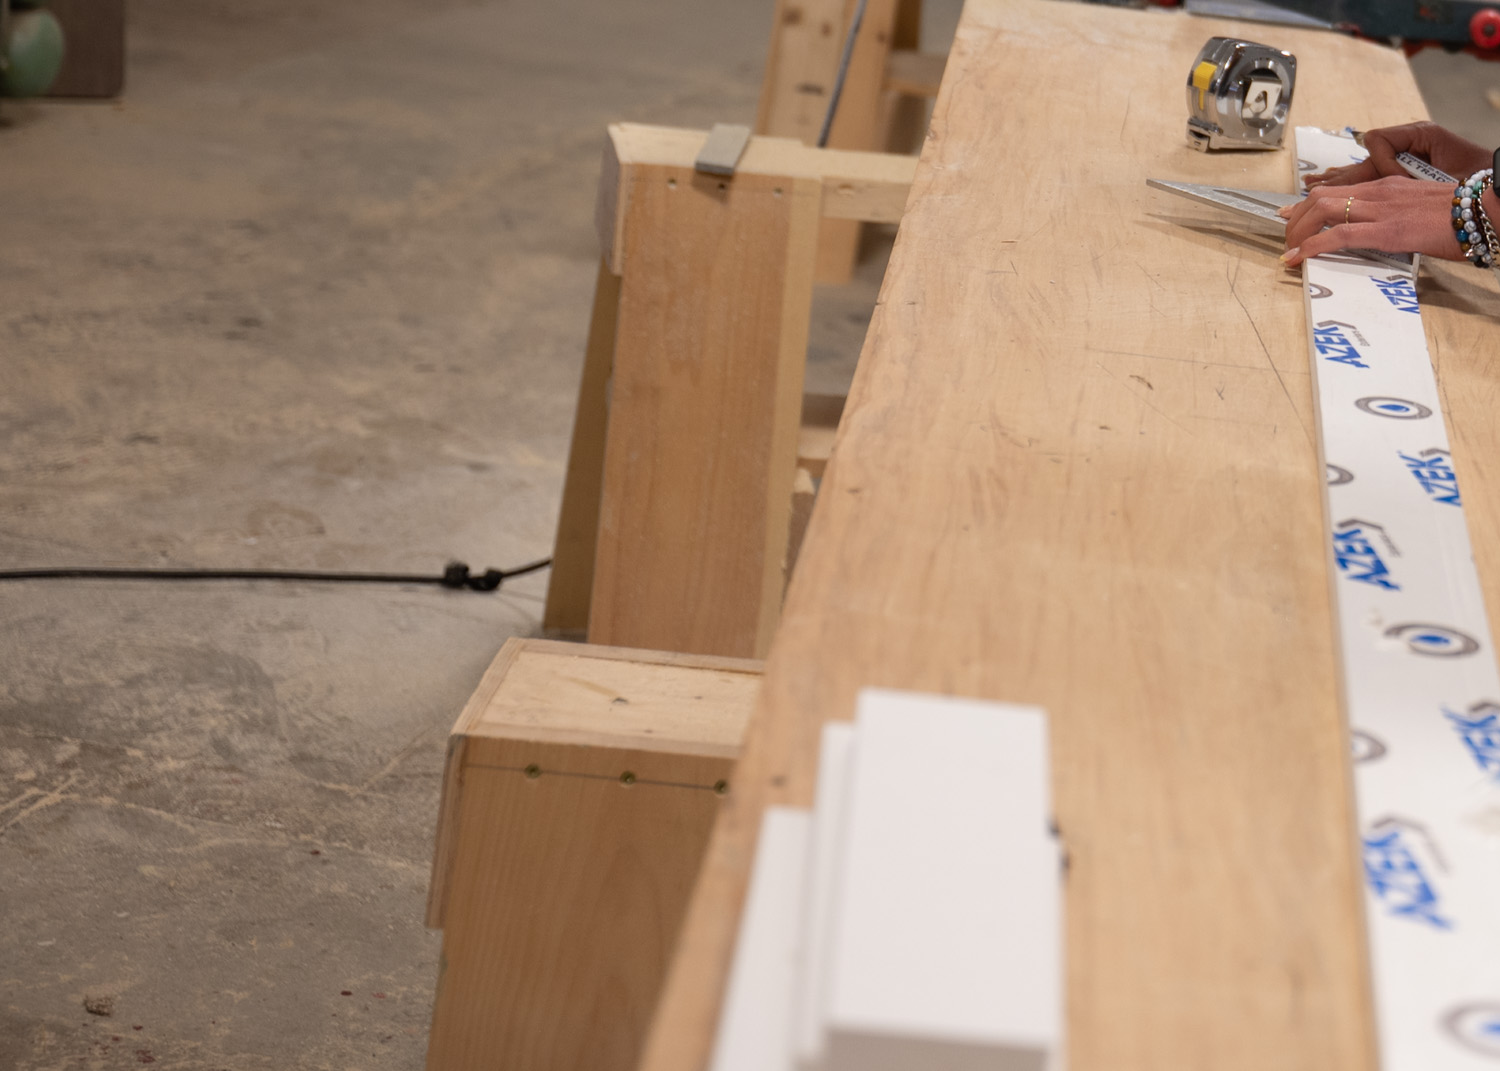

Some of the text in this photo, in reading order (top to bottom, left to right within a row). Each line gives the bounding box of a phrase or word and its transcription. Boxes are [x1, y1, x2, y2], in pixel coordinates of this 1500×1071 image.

[1416, 164, 1449, 184] TRAD
[1313, 326, 1370, 369] AZEK
[1333, 528, 1401, 591] AZEK
